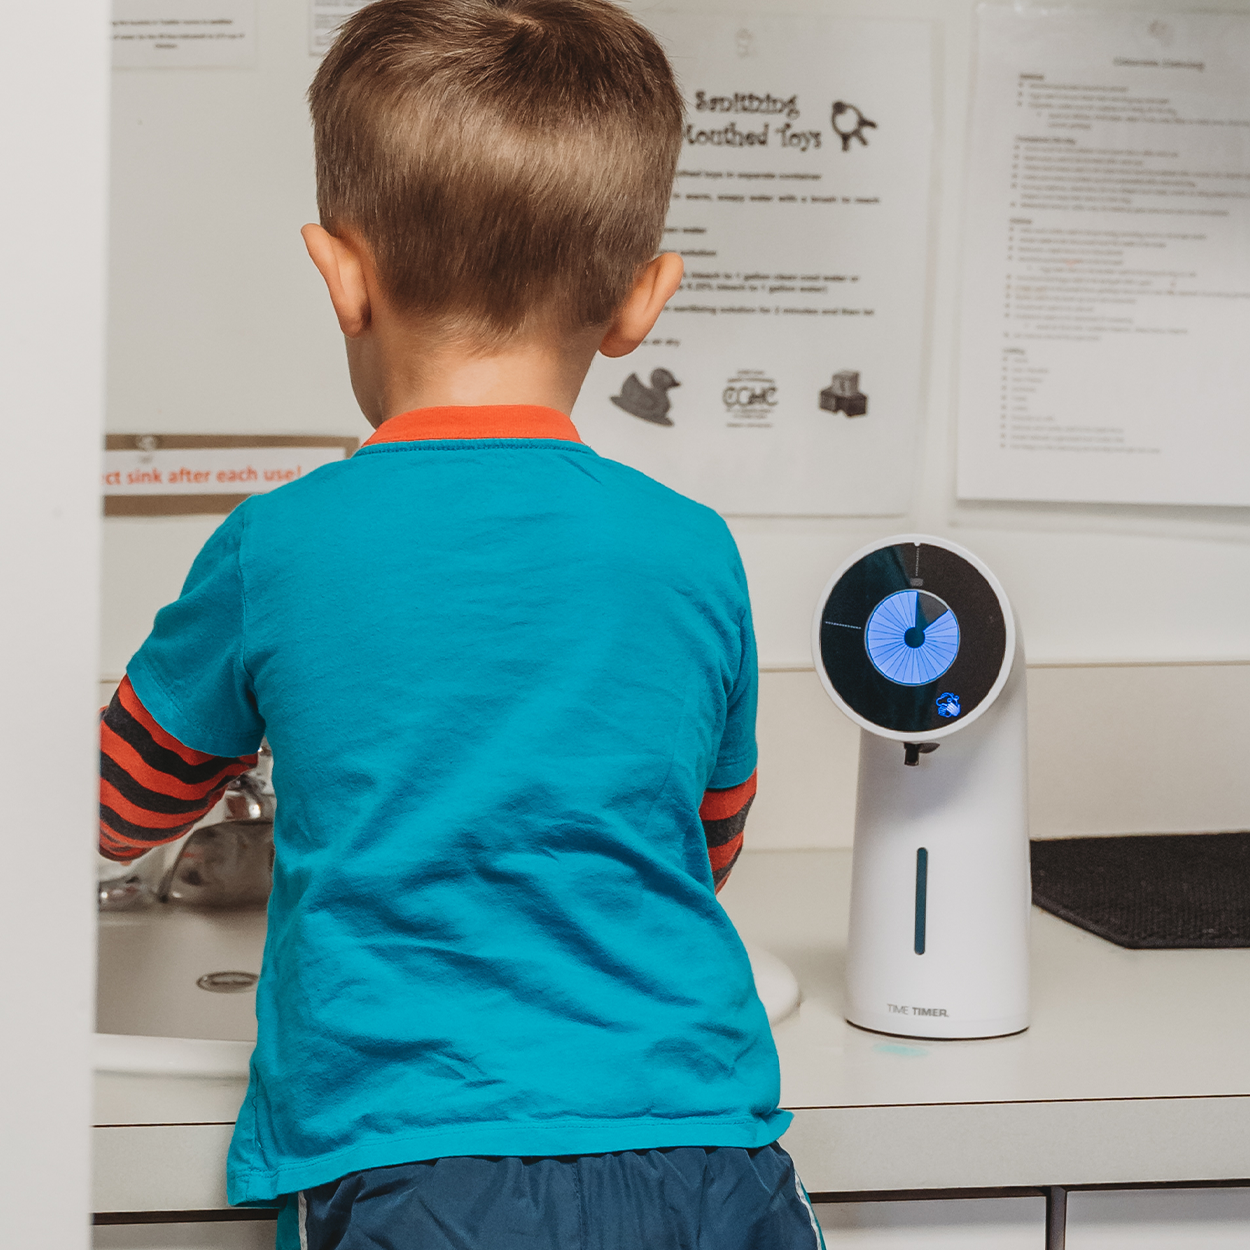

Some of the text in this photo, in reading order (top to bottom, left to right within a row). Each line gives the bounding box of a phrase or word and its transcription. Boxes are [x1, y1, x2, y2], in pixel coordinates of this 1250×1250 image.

[695, 90, 801, 121] Sanitizing
[774, 121, 823, 152] Toys
[126, 466, 162, 485] sink
[167, 466, 212, 484] after
[215, 466, 259, 483] each
[263, 465, 303, 482] use!
[887, 1003, 910, 1016] TIME
